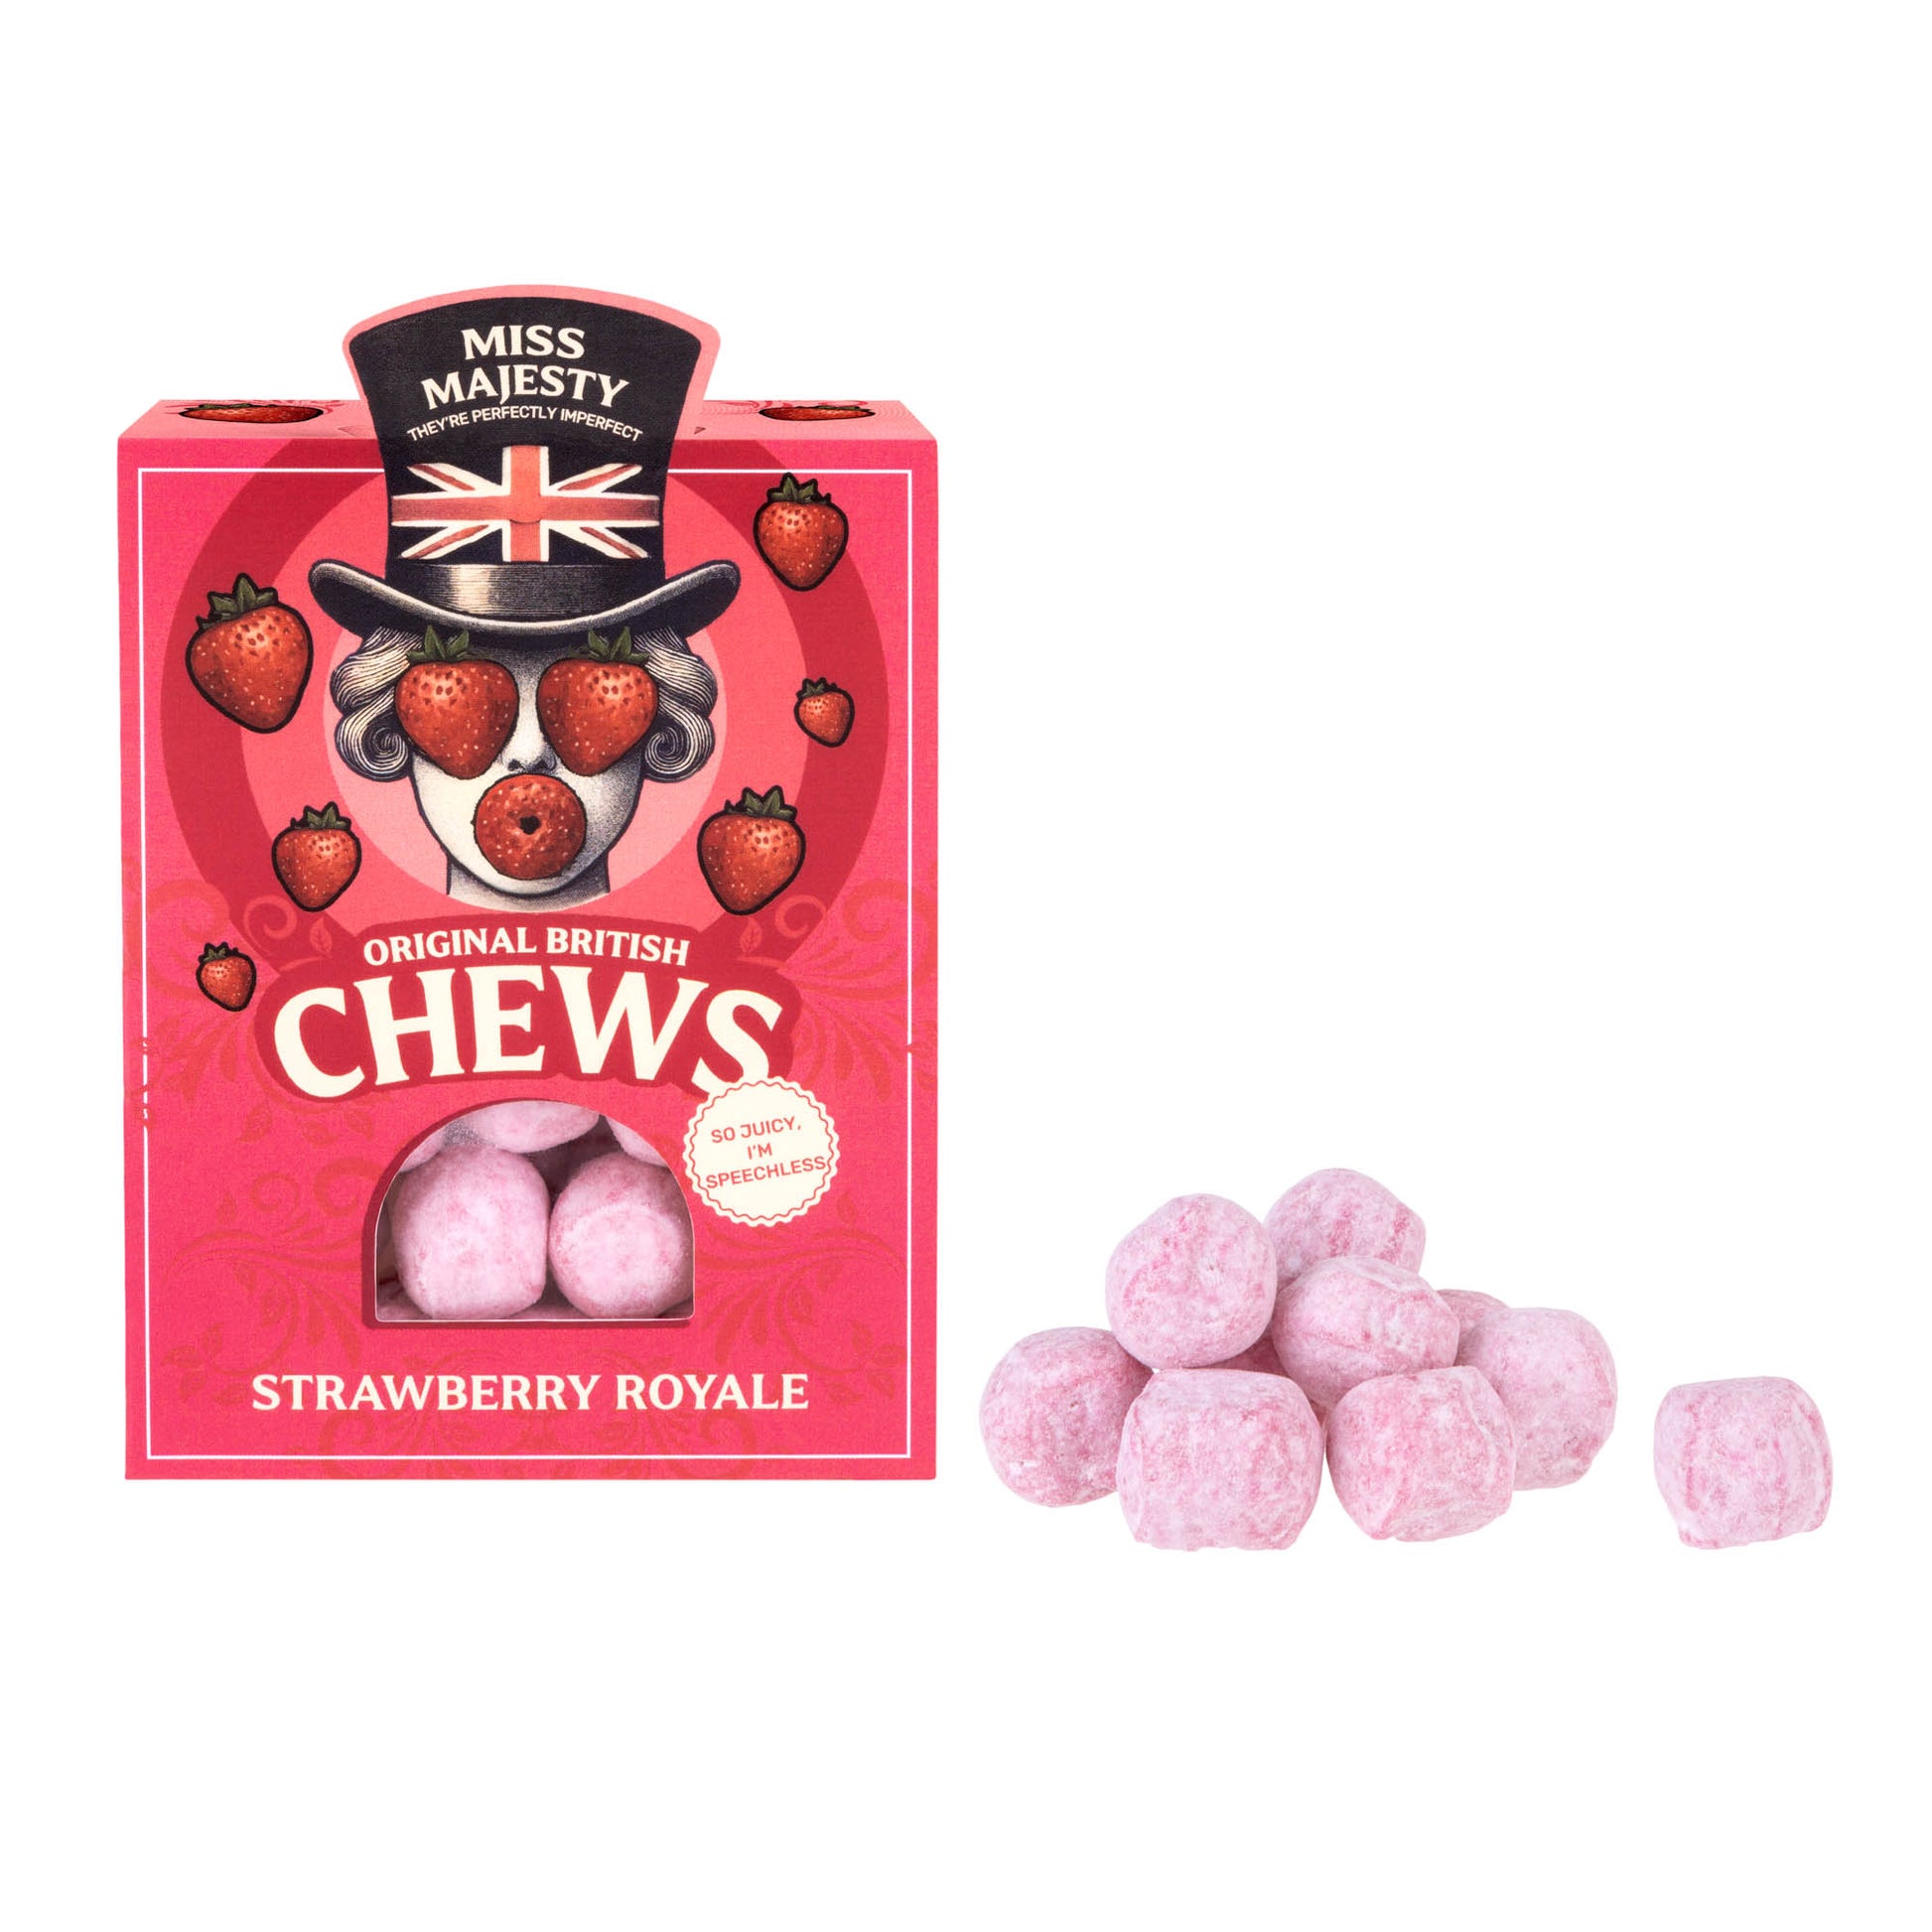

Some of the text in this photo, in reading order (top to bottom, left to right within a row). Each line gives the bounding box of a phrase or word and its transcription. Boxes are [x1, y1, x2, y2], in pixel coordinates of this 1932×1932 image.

[462, 325, 585, 359] MISS
[422, 364, 629, 409] MAJESTY
[407, 406, 643, 442] THEY'RE PERFECTLY IMPERFECT
[363, 927, 690, 965] ORIGINAL BRITISH
[274, 965, 782, 1098] CHEWS
[711, 1116, 801, 1143] SO JUICY,
[747, 1143, 772, 1160] I'M
[706, 1156, 826, 1188] SPEECHLESS
[251, 1373, 809, 1411] STRAWBERRY ROYALE
